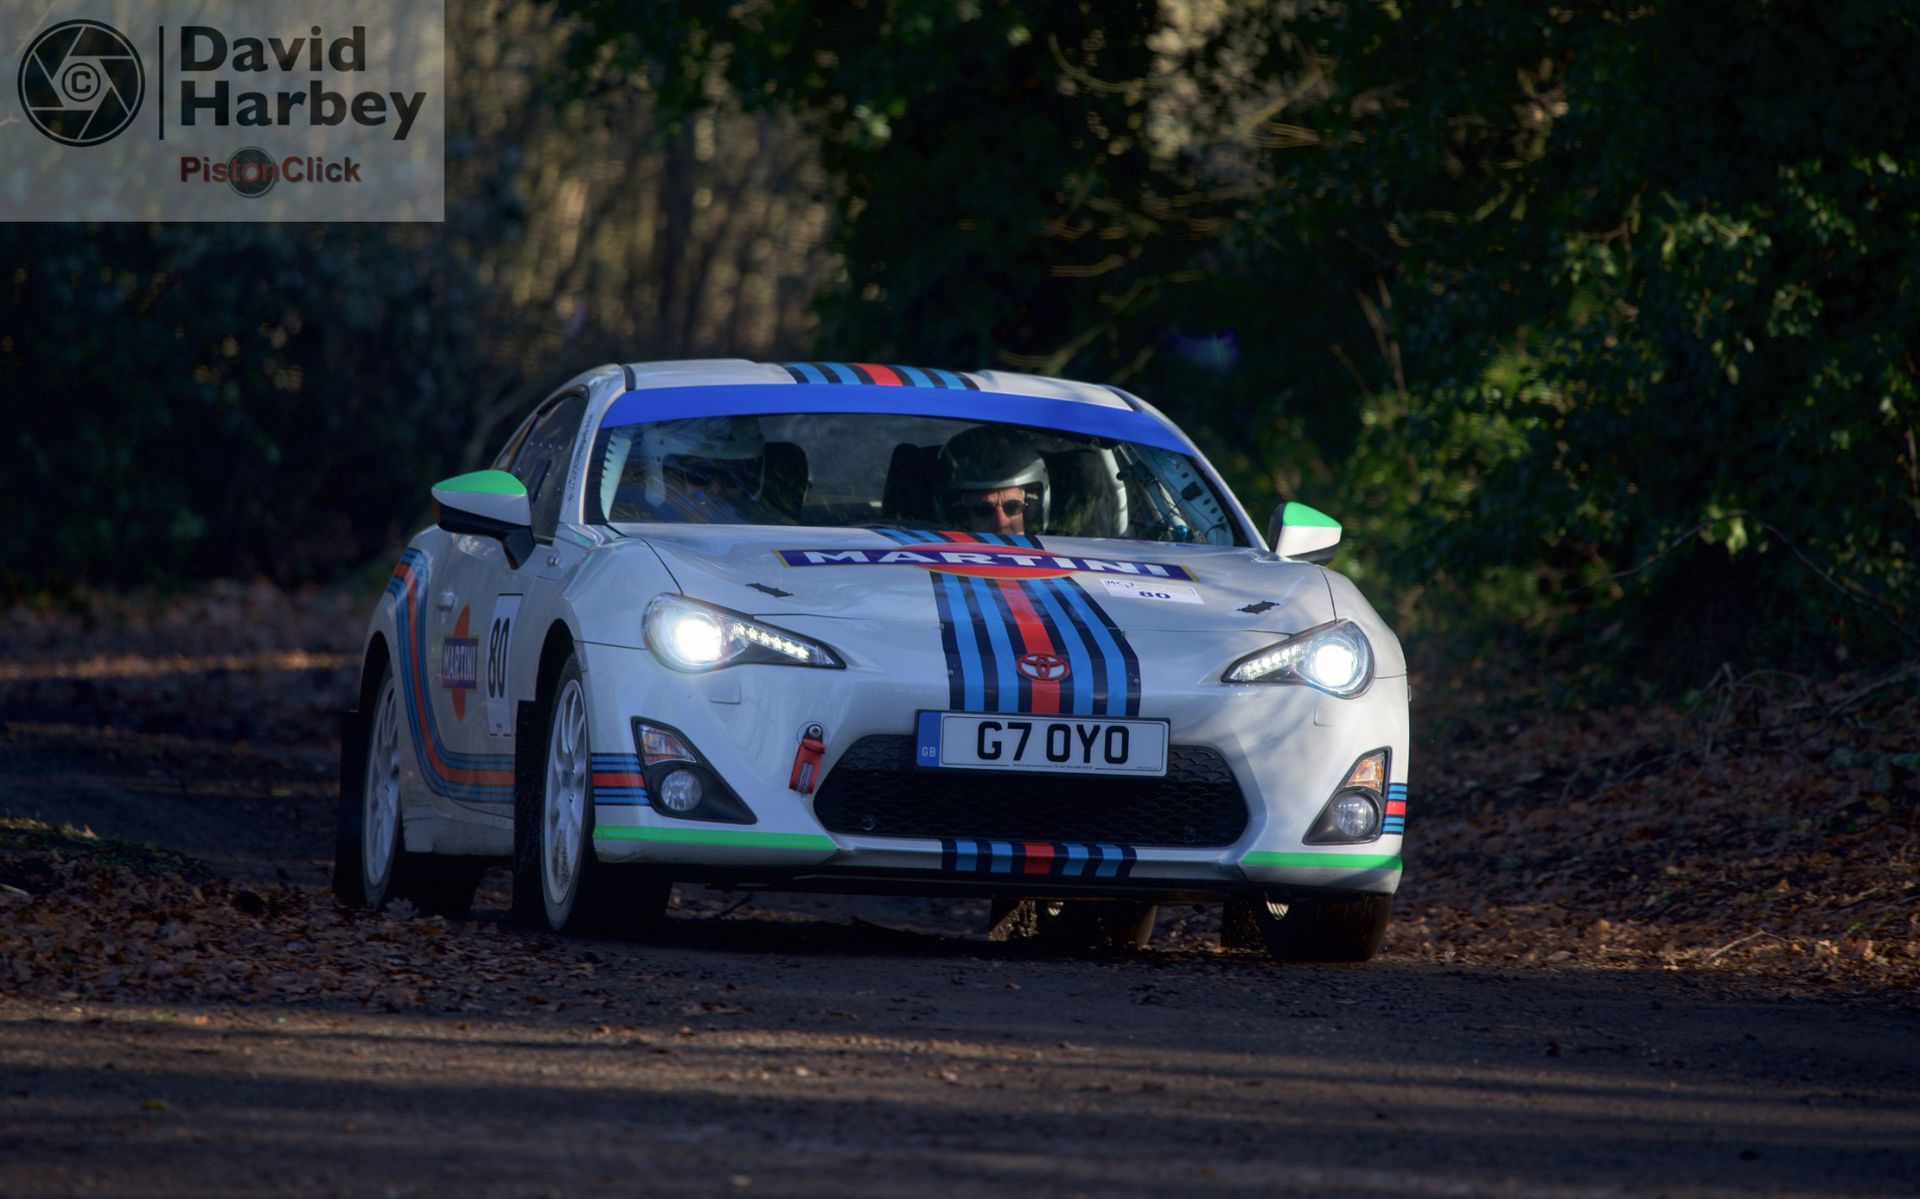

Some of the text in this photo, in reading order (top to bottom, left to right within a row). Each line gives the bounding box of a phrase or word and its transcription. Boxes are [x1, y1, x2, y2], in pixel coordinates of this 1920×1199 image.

[802, 551, 1170, 576] MARTINI
[1138, 591, 1171, 599] 80
[443, 645, 477, 680] MARTINI
[488, 618, 510, 698] 80
[921, 746, 937, 758] GB
[977, 721, 1129, 765] G7 OYO
